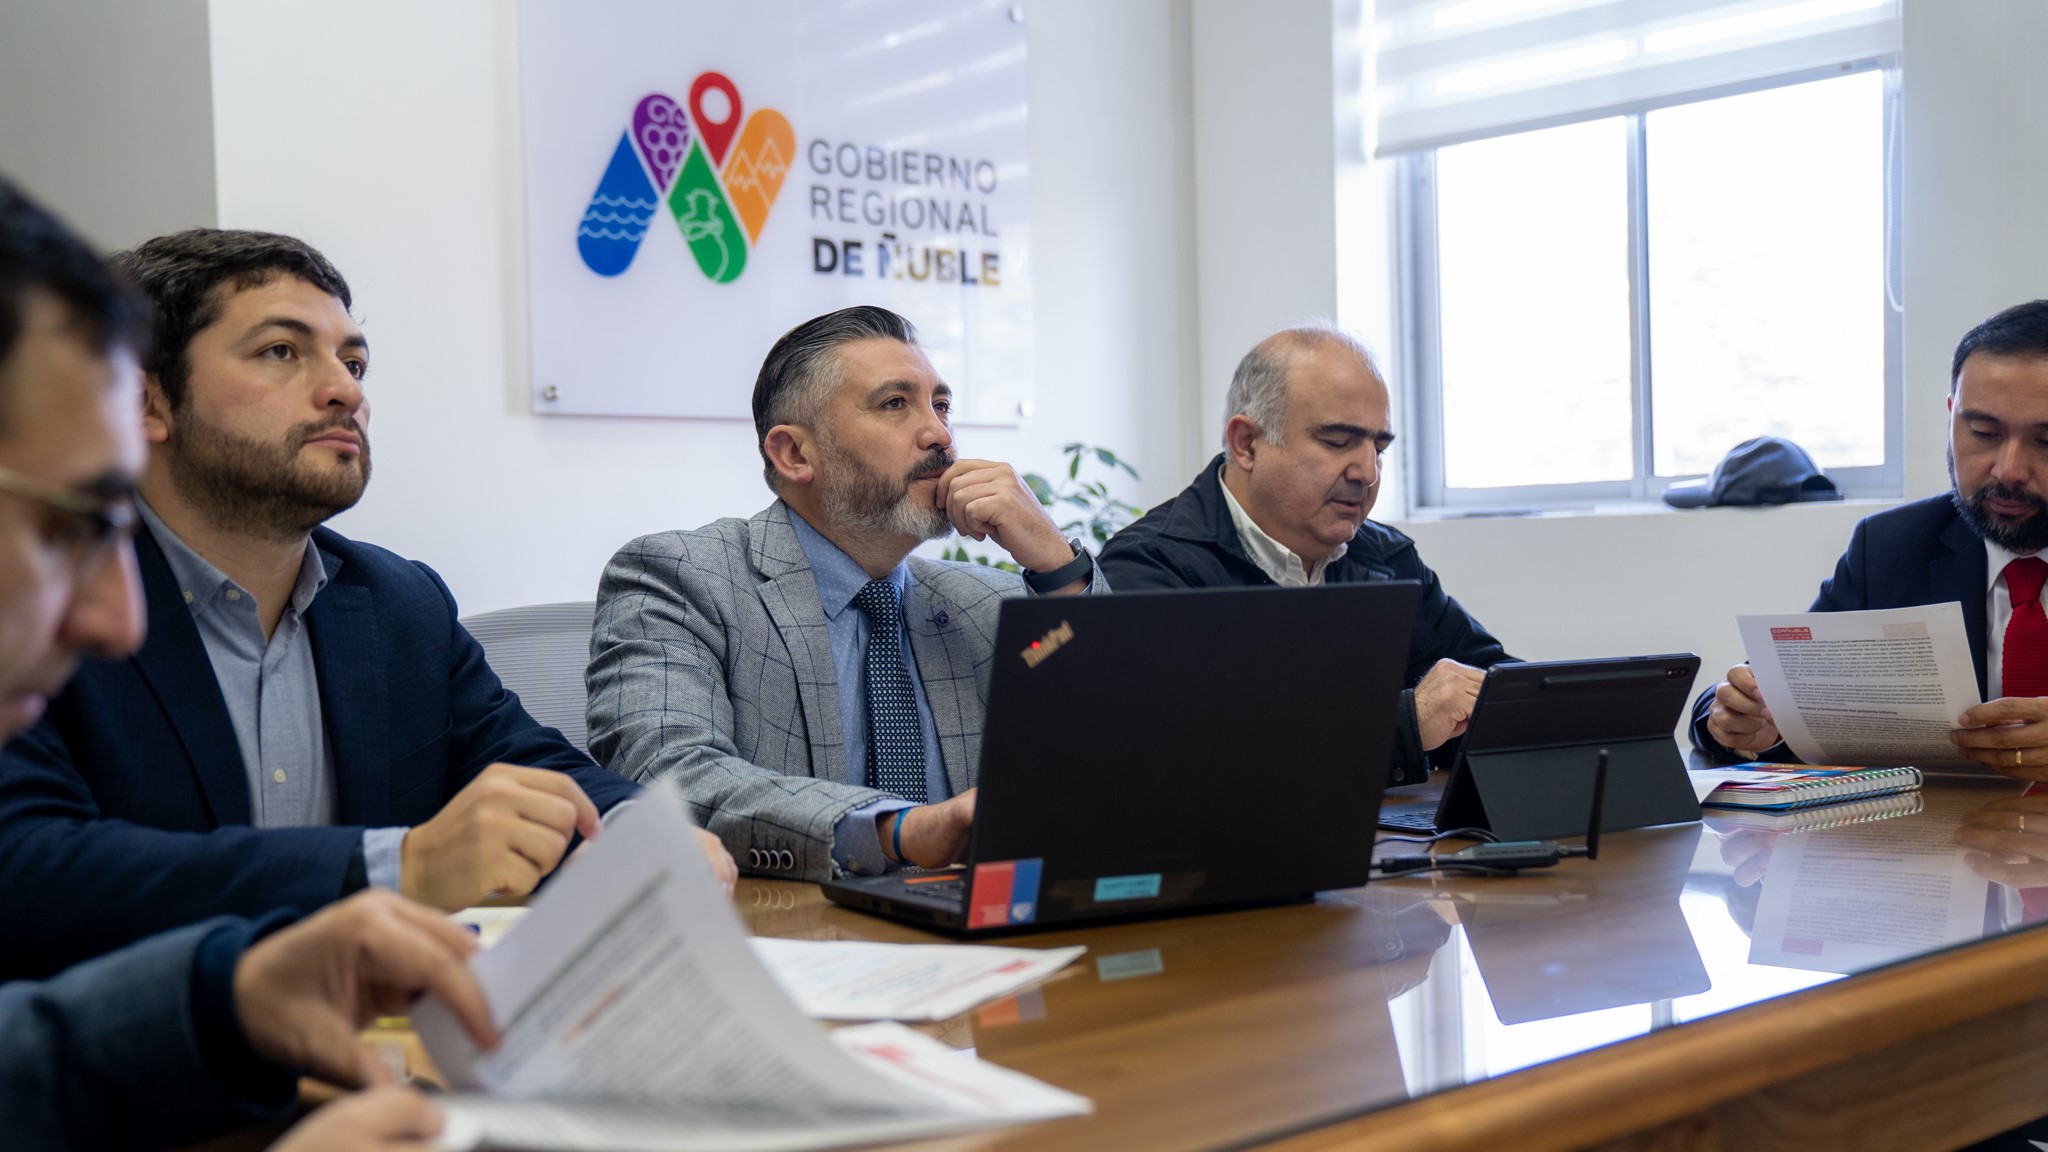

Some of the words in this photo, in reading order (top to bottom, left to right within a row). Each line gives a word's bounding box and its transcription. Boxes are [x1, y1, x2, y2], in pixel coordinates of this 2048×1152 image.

[808, 138, 998, 194] GOBIERNO
[809, 184, 999, 238] REGIONAL
[813, 237, 864, 278] DE
[876, 232, 1001, 287] ÑUBLE
